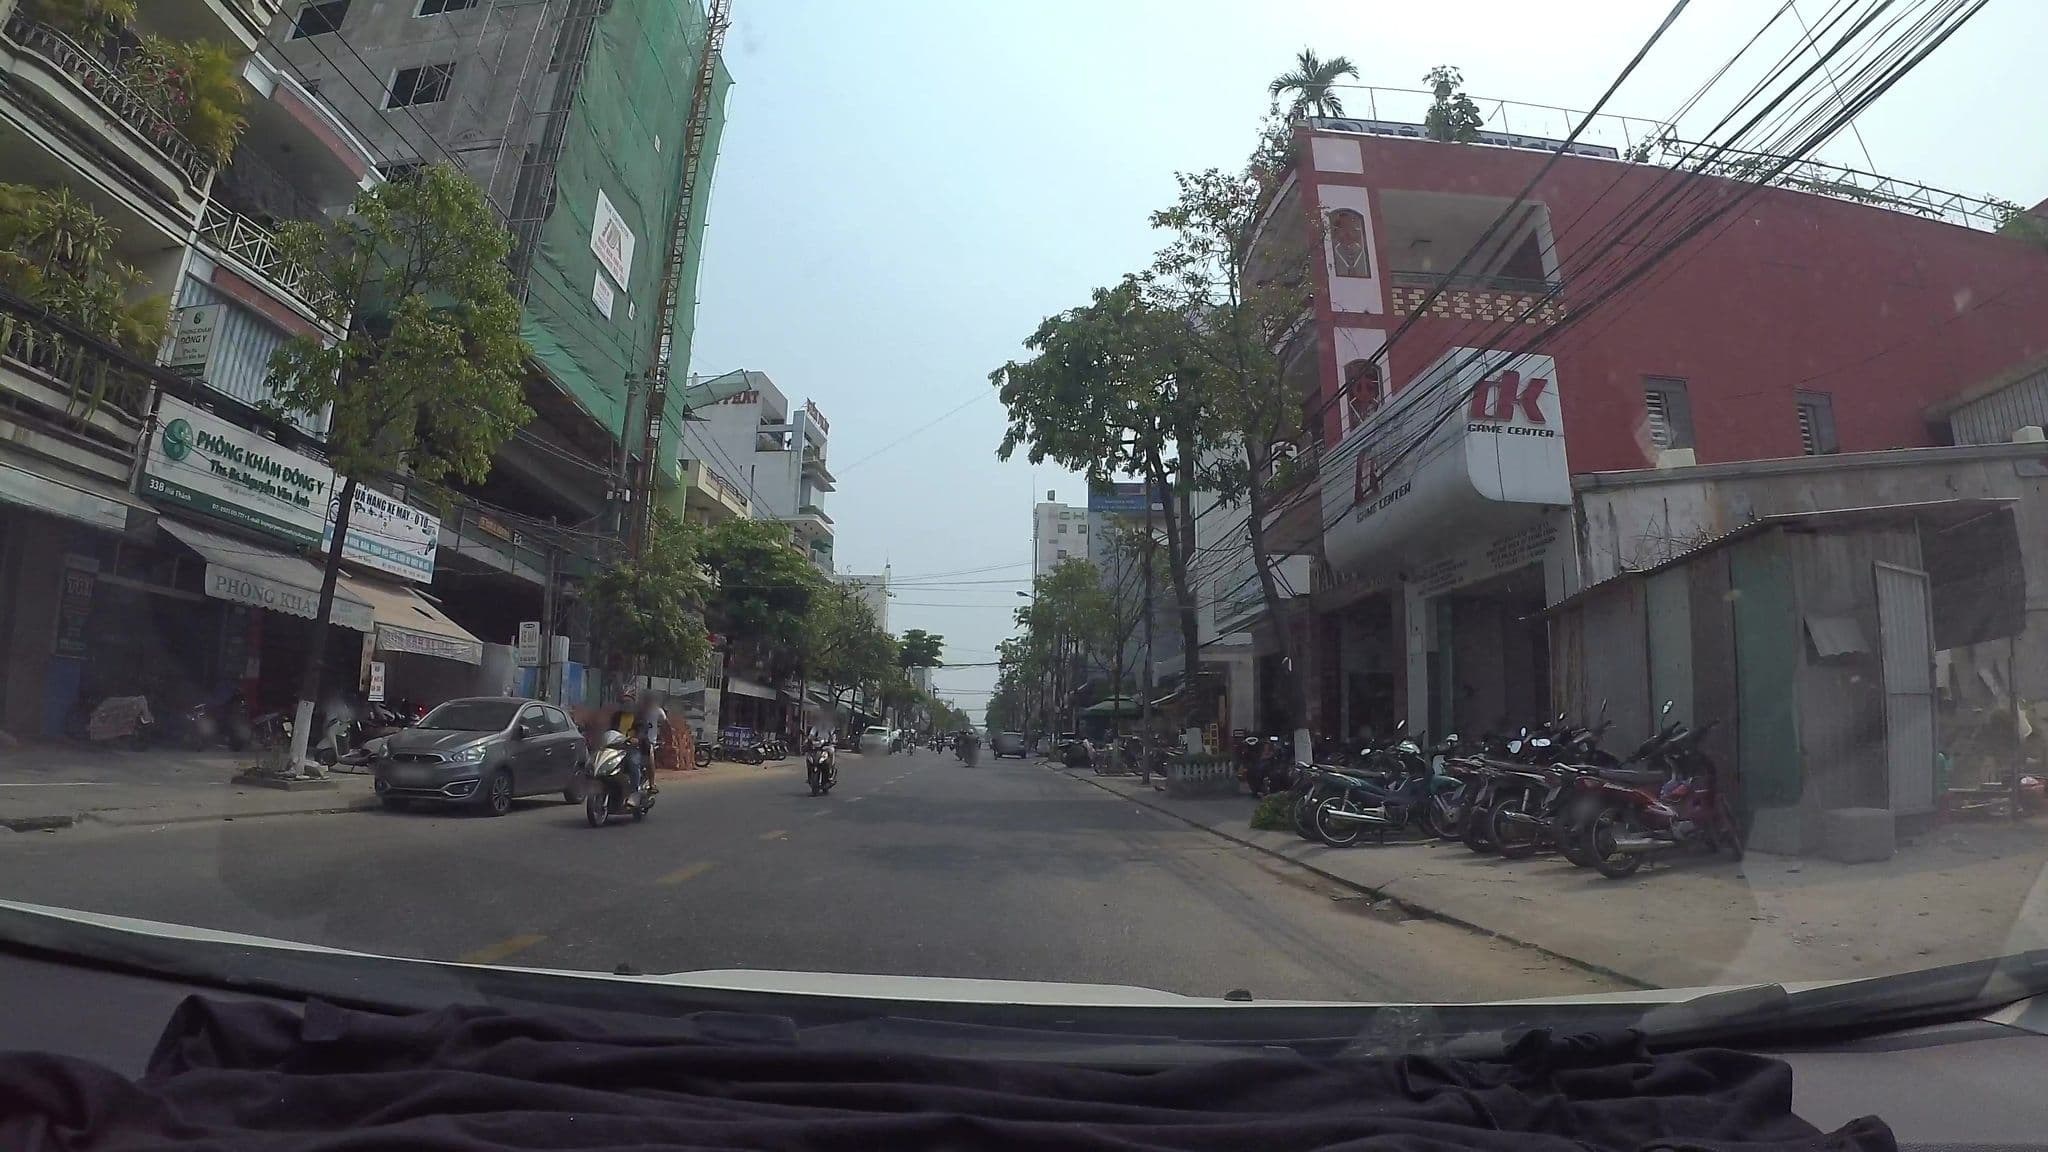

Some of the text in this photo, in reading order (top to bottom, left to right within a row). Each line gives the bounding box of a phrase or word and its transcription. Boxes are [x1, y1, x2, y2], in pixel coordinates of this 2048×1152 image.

[1467, 423, 1555, 438] GAME CENTER
[197, 430, 244, 463] PHÒNG
[244, 451, 282, 479] KHÁM
[315, 480, 325, 495] Y
[149, 479, 165, 492] 33B
[1379, 480, 1411, 510] CENTER
[214, 574, 275, 604] PHÒNG
